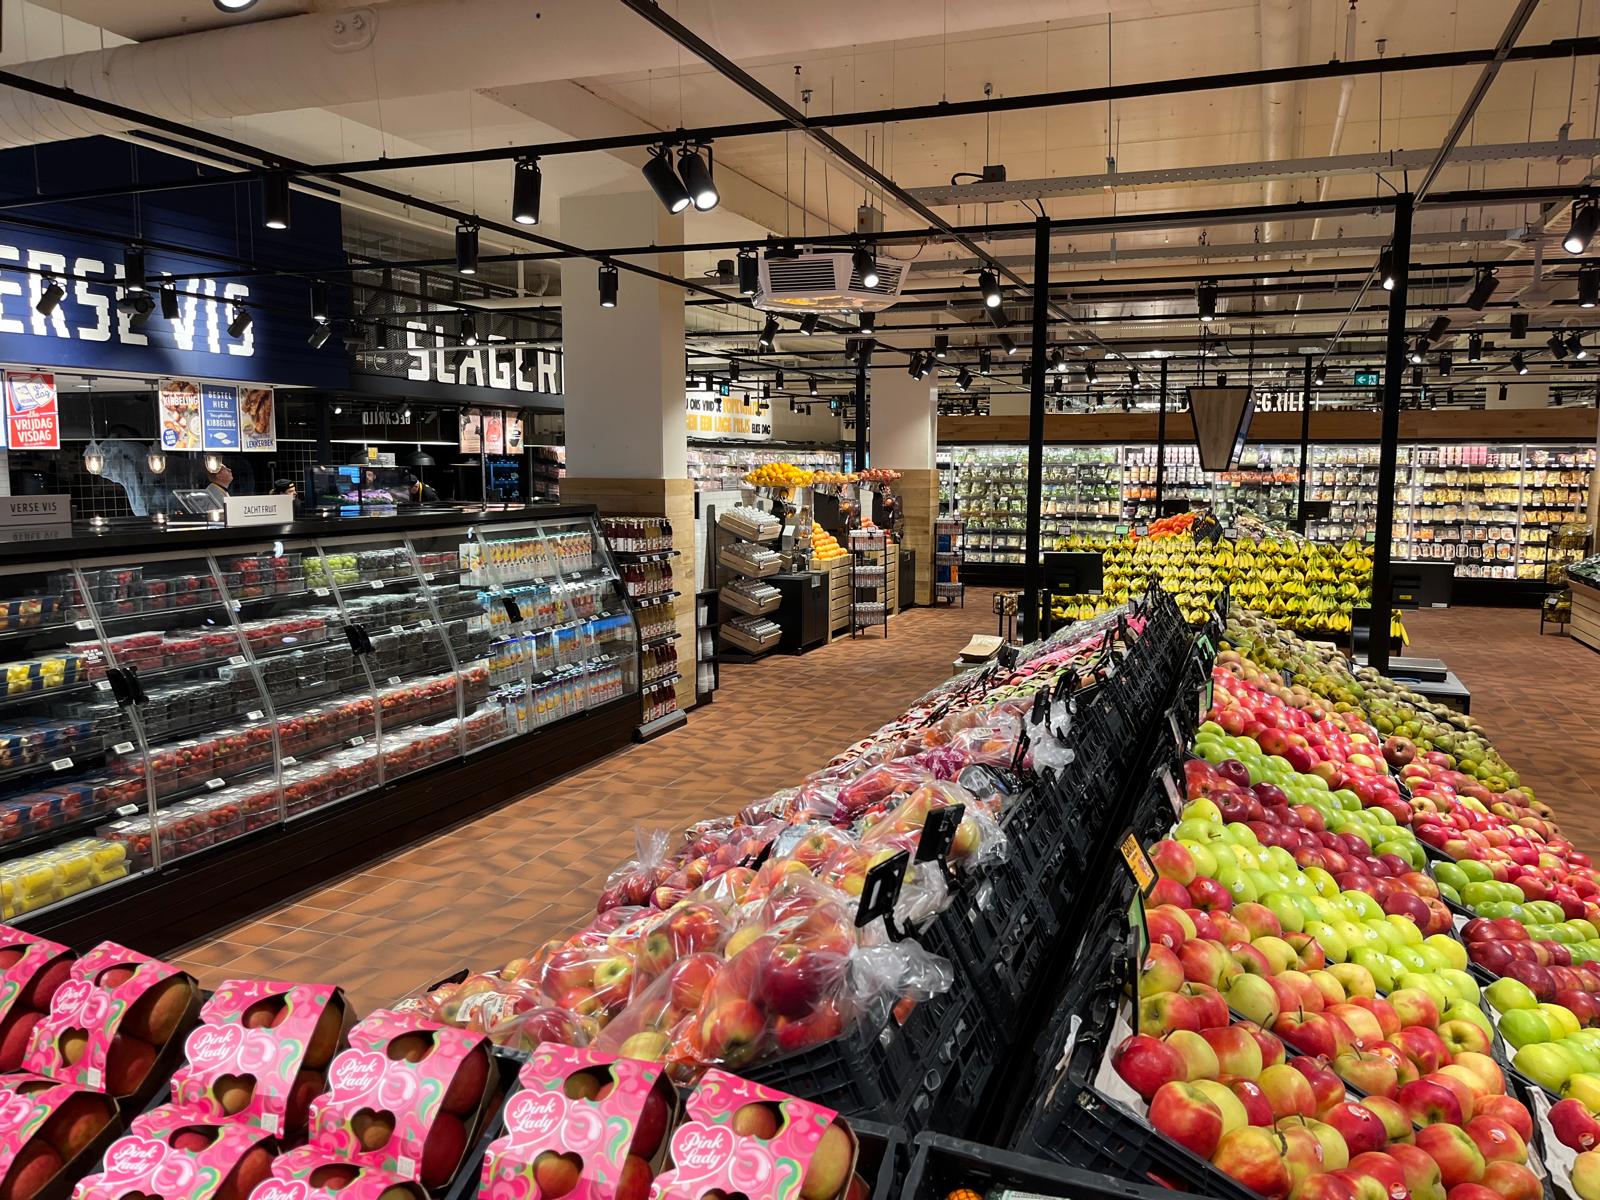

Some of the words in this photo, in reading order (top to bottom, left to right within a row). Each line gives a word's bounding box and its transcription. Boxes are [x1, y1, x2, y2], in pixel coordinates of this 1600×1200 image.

[161, 271, 255, 357] VIS
[208, 391, 232, 400] BESTEL
[212, 400, 229, 409] HIER
[15, 418, 53, 431] VRIJDAG
[18, 430, 52, 443] VISDAG
[10, 502, 40, 513] VERSE
[41, 501, 57, 512] VIS
[243, 505, 261, 515] ZACHT
[193, 1028, 234, 1050] Pink
[191, 1043, 231, 1062] Lady
[336, 1057, 378, 1077] Pink
[335, 1072, 374, 1091] Lady
[512, 1097, 556, 1119] Pink
[512, 1113, 554, 1134] Lady
[112, 1143, 158, 1160] Pink
[679, 1131, 724, 1153] Pink
[108, 1157, 150, 1175] Lady
[679, 1147, 722, 1170] Lady
